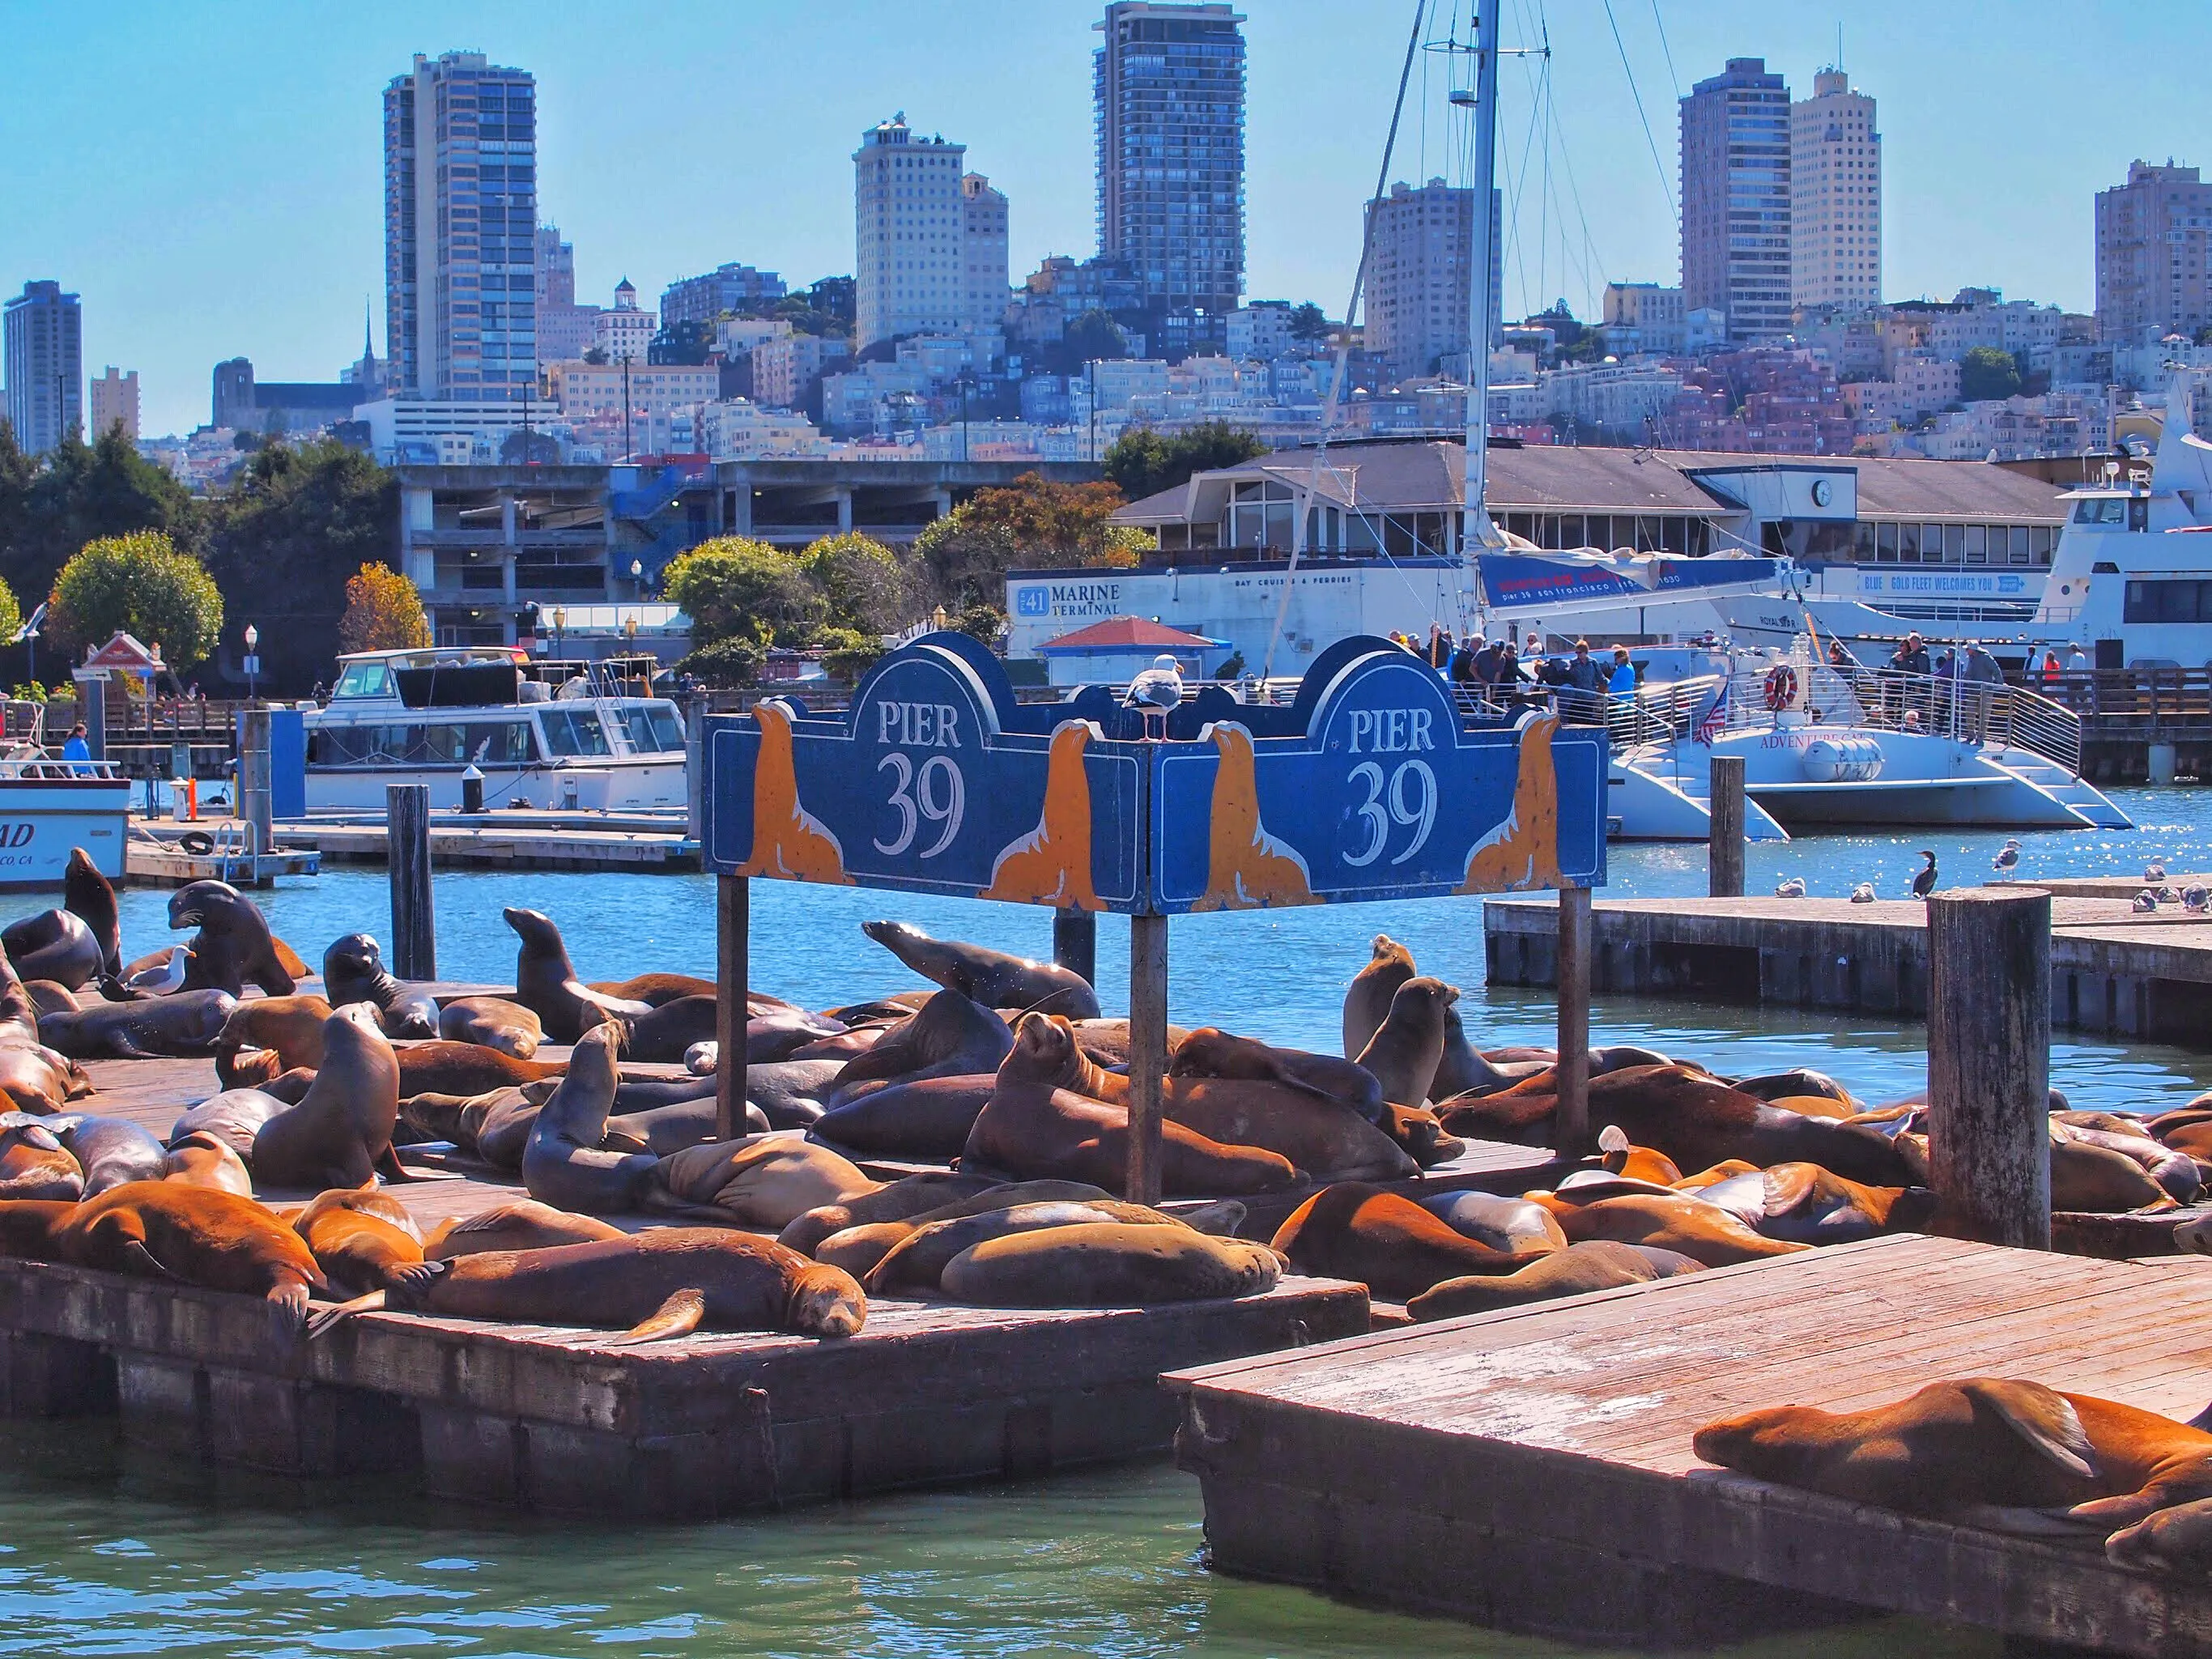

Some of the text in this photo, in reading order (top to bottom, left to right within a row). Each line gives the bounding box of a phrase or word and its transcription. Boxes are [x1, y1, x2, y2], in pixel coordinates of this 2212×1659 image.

[1052, 585, 1120, 601] MARINE
[1502, 592, 1517, 602] pier
[1555, 583, 1610, 595] francisco
[1865, 576, 1883, 590] BLUE
[1891, 576, 1910, 590] GOLD
[1912, 576, 1932, 590] FLEET
[1934, 576, 1976, 591] WELCOMES
[1977, 576, 1993, 591] YOU
[1026, 592, 1045, 611] 41
[1053, 604, 1120, 615] TERMINAL
[1759, 616, 1780, 626] ROYAL
[878, 701, 962, 748] PIER
[1348, 708, 1436, 753] PIER
[874, 753, 964, 858] 39
[1342, 759, 1437, 866] 39
[19, 856, 32, 865] CA
